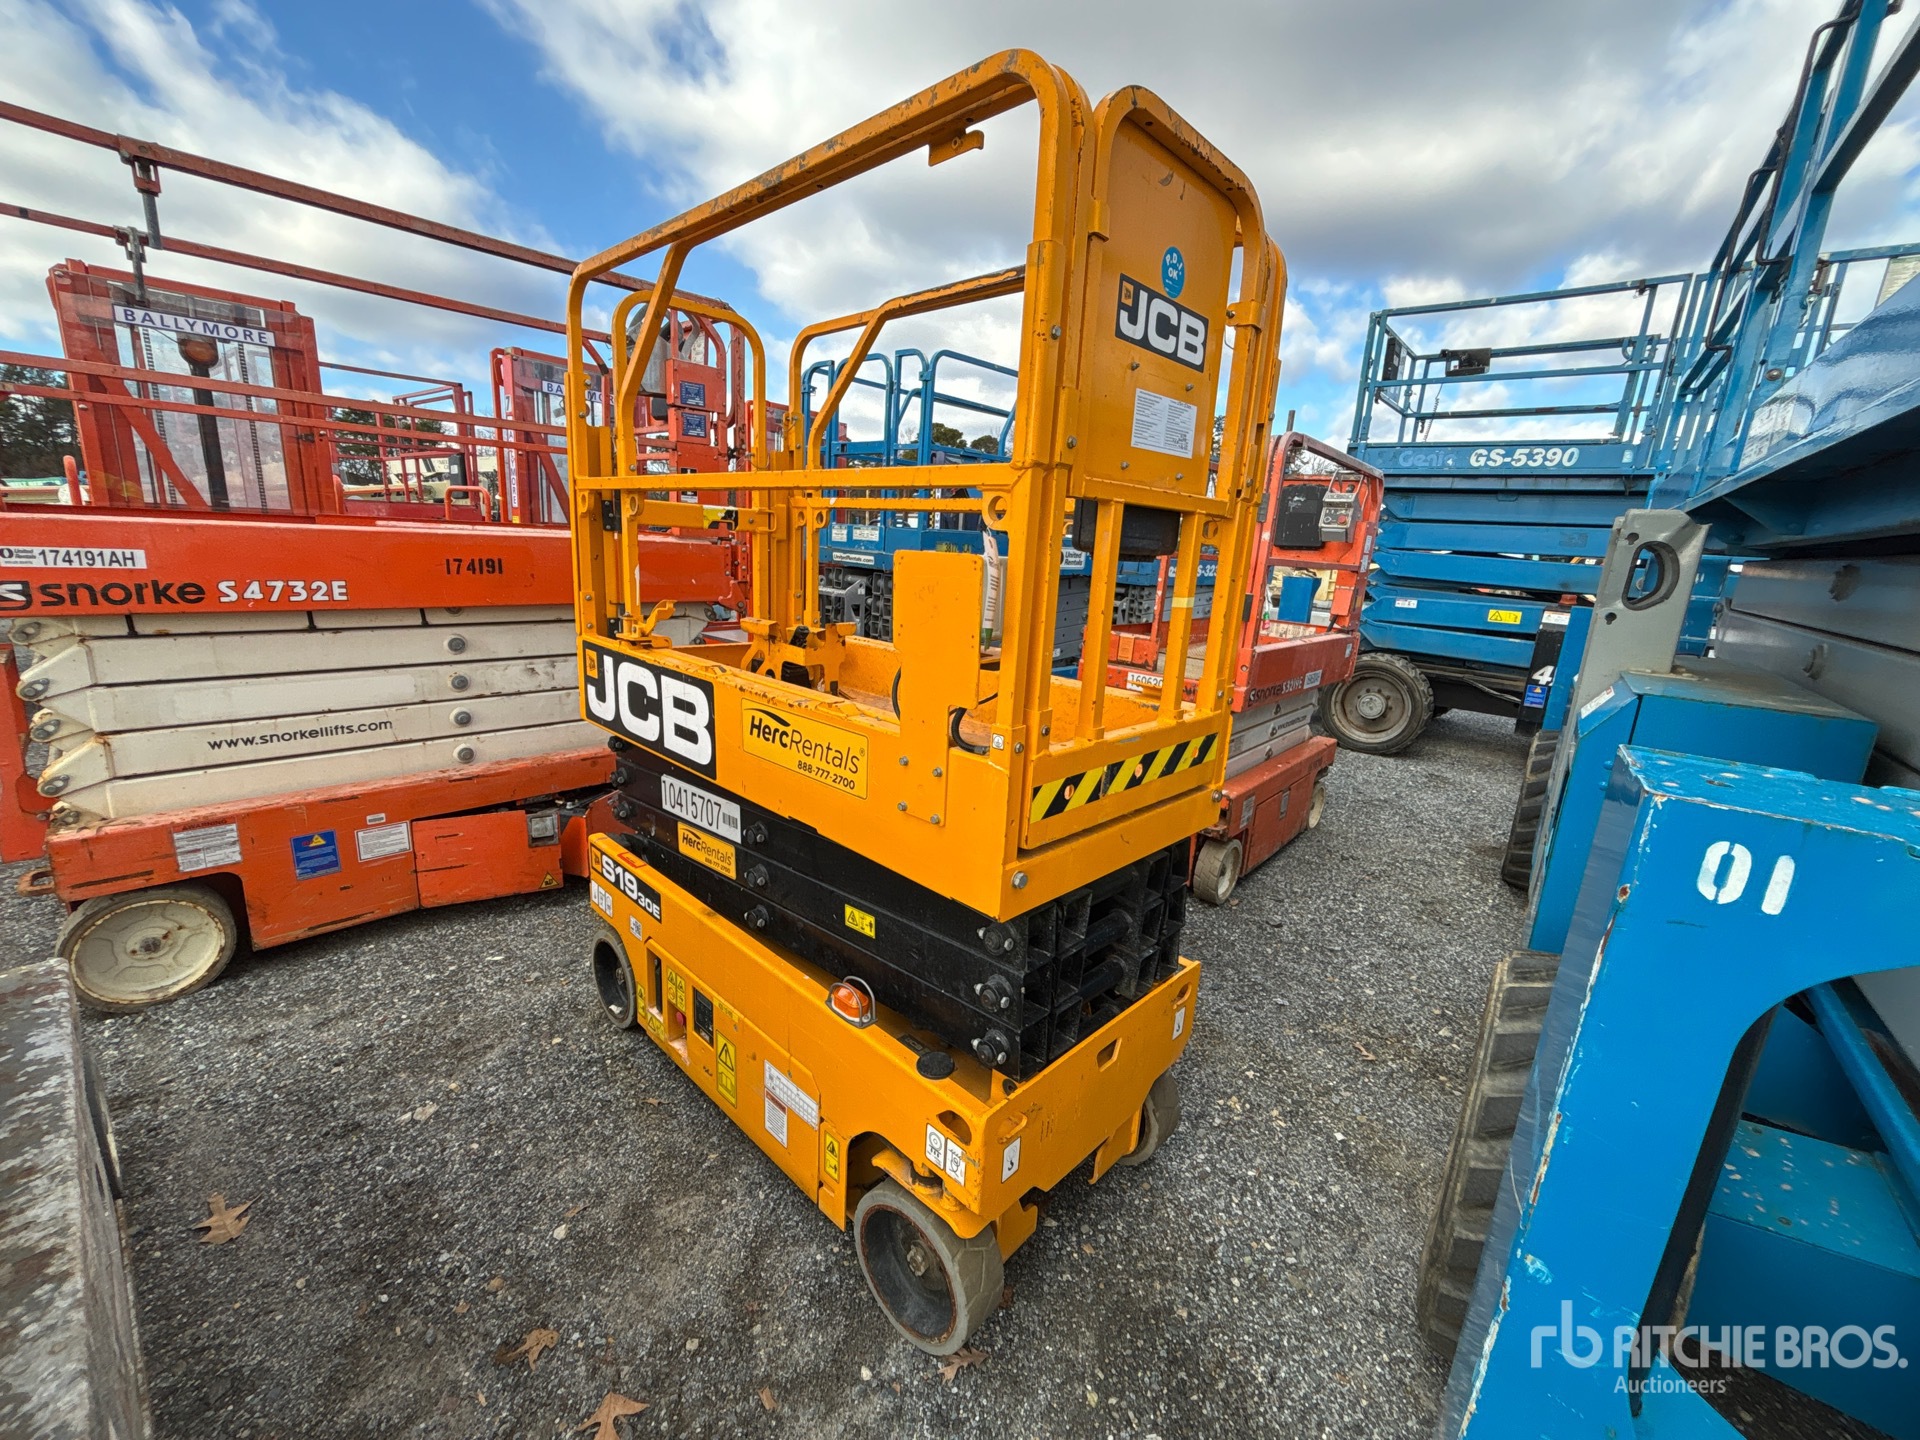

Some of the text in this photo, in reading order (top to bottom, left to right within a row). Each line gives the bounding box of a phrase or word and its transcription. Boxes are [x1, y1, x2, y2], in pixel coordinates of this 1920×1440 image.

[1168, 267, 1179, 280] OK
[123, 308, 268, 344] BALLYMORE
[1119, 289, 1206, 366] JCB
[1469, 447, 1580, 468] GS-5390
[38, 549, 136, 567] 174191AH
[445, 557, 504, 575] 174191
[833, 554, 874, 564] UnitedRentals.com
[1064, 558, 1083, 566] Rentals
[1065, 551, 1082, 559] United
[39, 579, 349, 607] snorke S4732E
[587, 654, 712, 766] JCB
[207, 720, 393, 751] www.snorkellifts.com
[797, 759, 856, 790] 888-777-2700
[662, 780, 722, 830] 10415707
